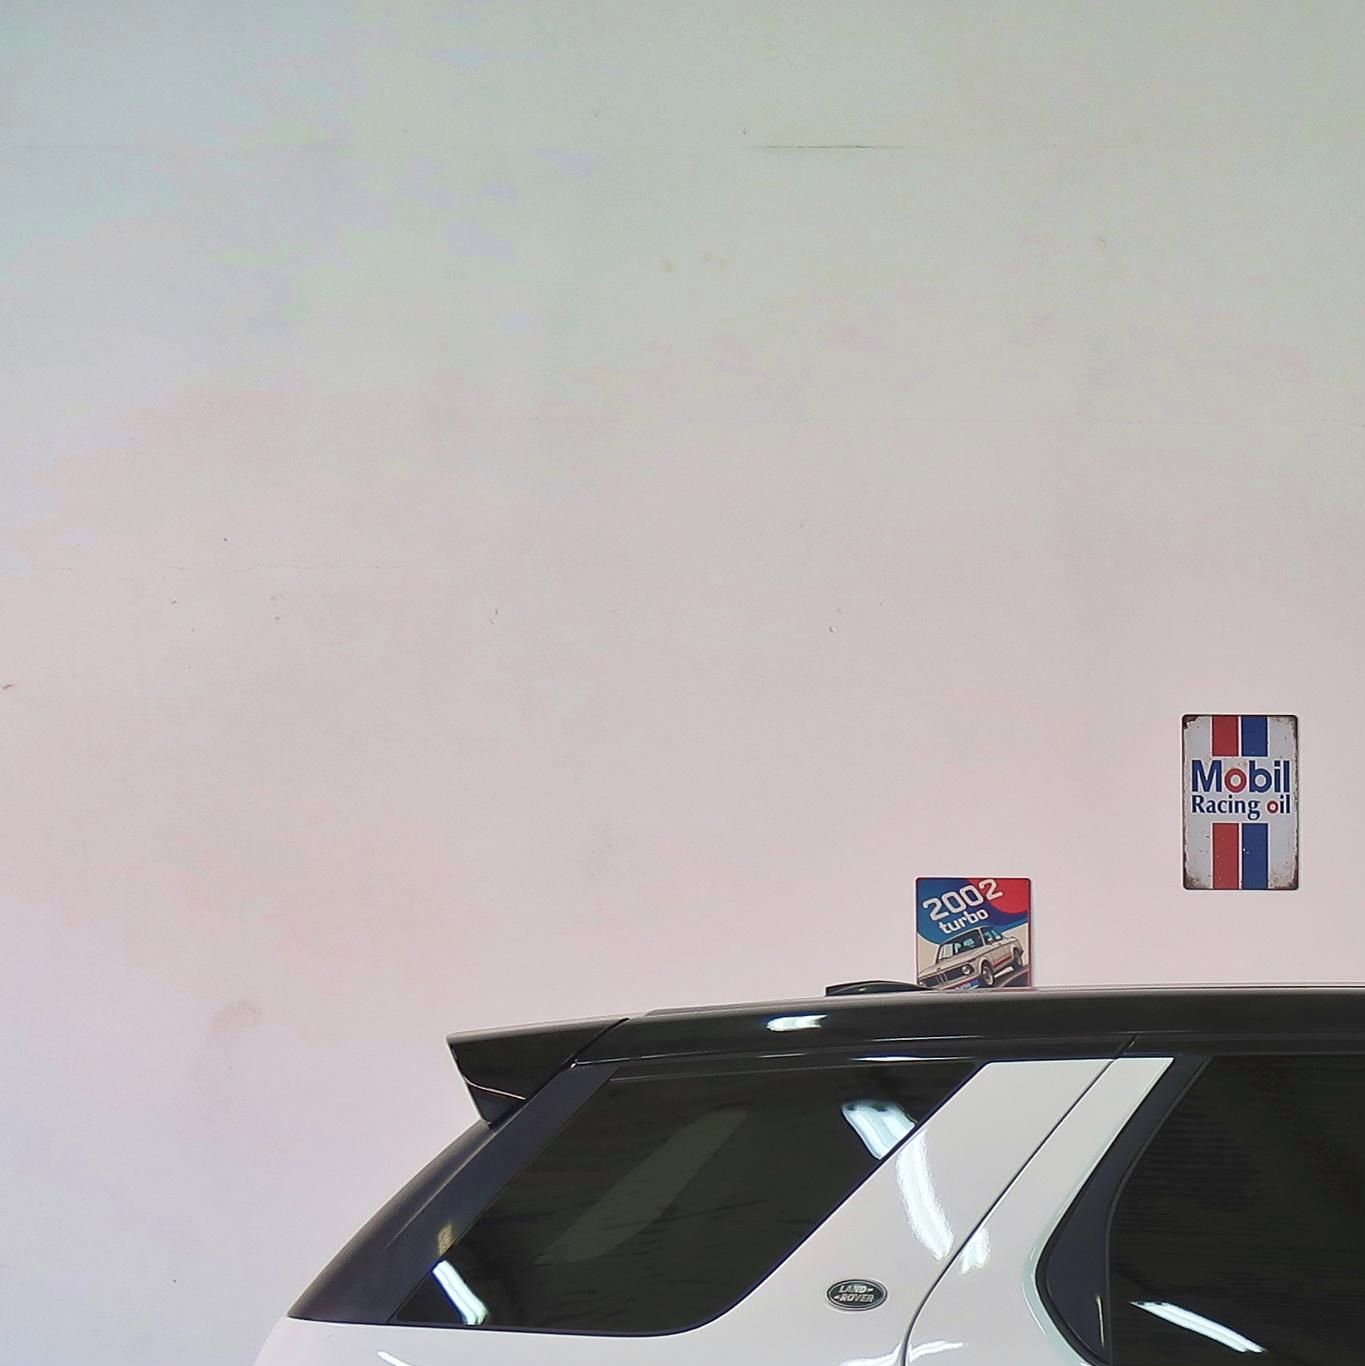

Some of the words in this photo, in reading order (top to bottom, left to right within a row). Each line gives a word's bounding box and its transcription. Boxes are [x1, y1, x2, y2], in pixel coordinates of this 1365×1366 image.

[1191, 759, 1291, 793] Mobil
[1191, 794, 1261, 820] Racing
[1266, 794, 1291, 814] oil
[922, 878, 1004, 921] 2002
[938, 908, 989, 934] turbo
